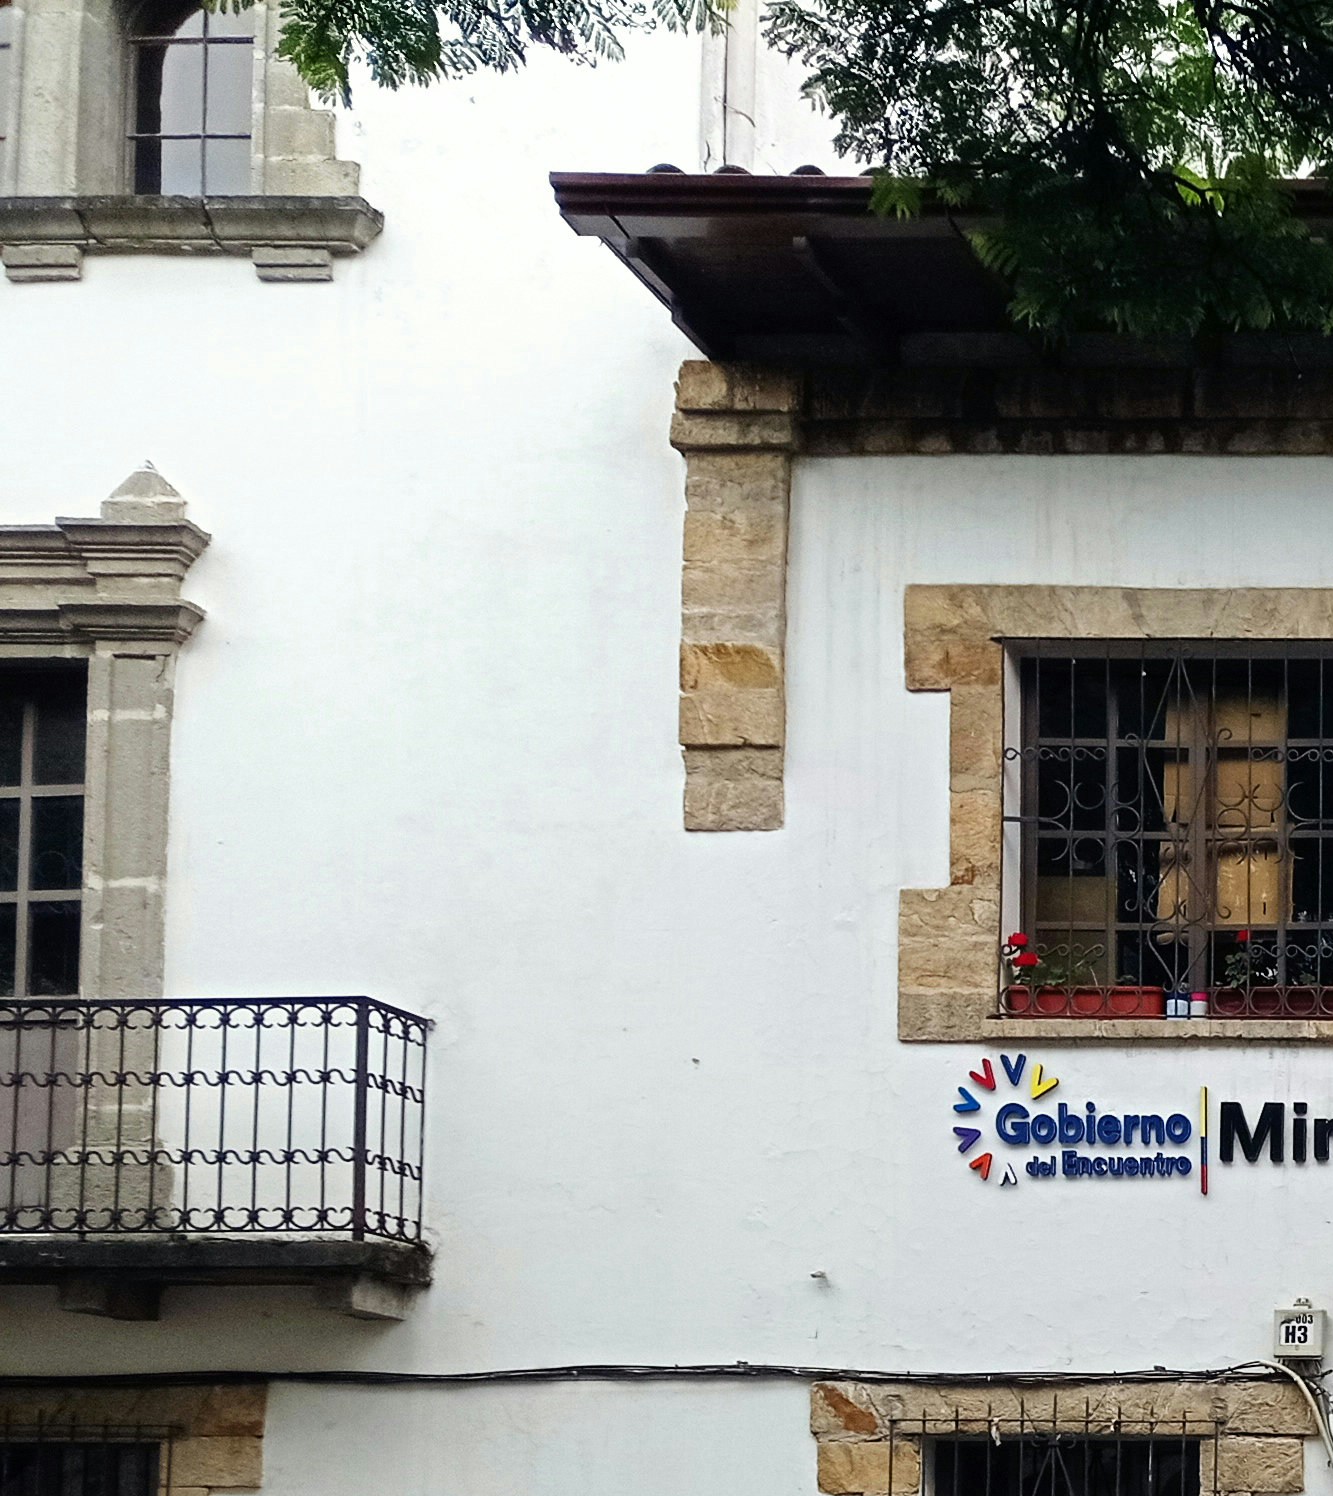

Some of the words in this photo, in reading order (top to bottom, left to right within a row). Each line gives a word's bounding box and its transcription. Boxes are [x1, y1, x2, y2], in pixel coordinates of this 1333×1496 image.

[995, 1101, 1192, 1146] Gobierno
[1025, 1155, 1057, 1177] del
[1061, 1150, 1192, 1178] Encuentro
[1284, 1325, 1308, 1344] H3
